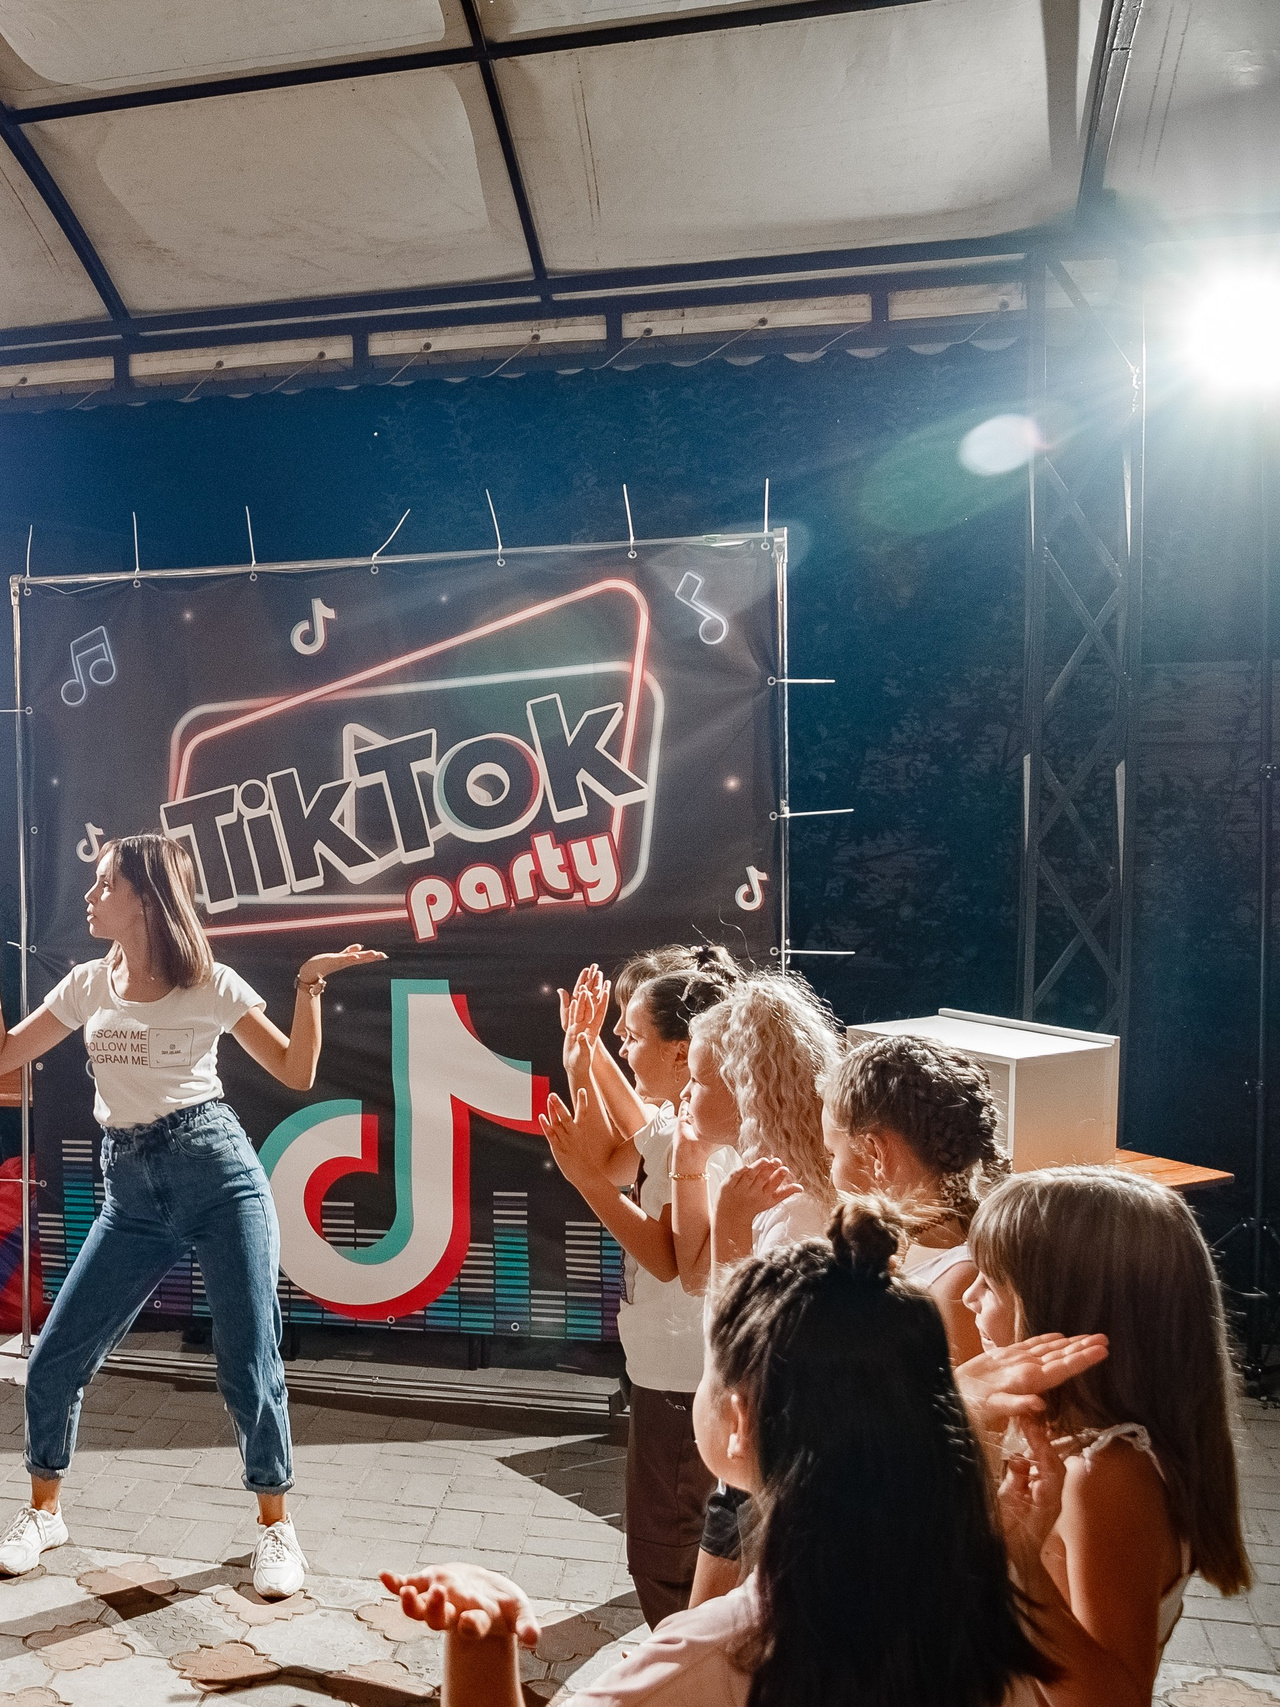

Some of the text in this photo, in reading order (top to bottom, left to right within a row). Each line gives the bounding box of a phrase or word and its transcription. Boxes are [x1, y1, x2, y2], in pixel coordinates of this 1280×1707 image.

[406, 832, 621, 941] party
[91, 1029, 147, 1040] #SCAN ME
[130, 1043, 148, 1053] ME
[132, 1055, 149, 1066] ME
